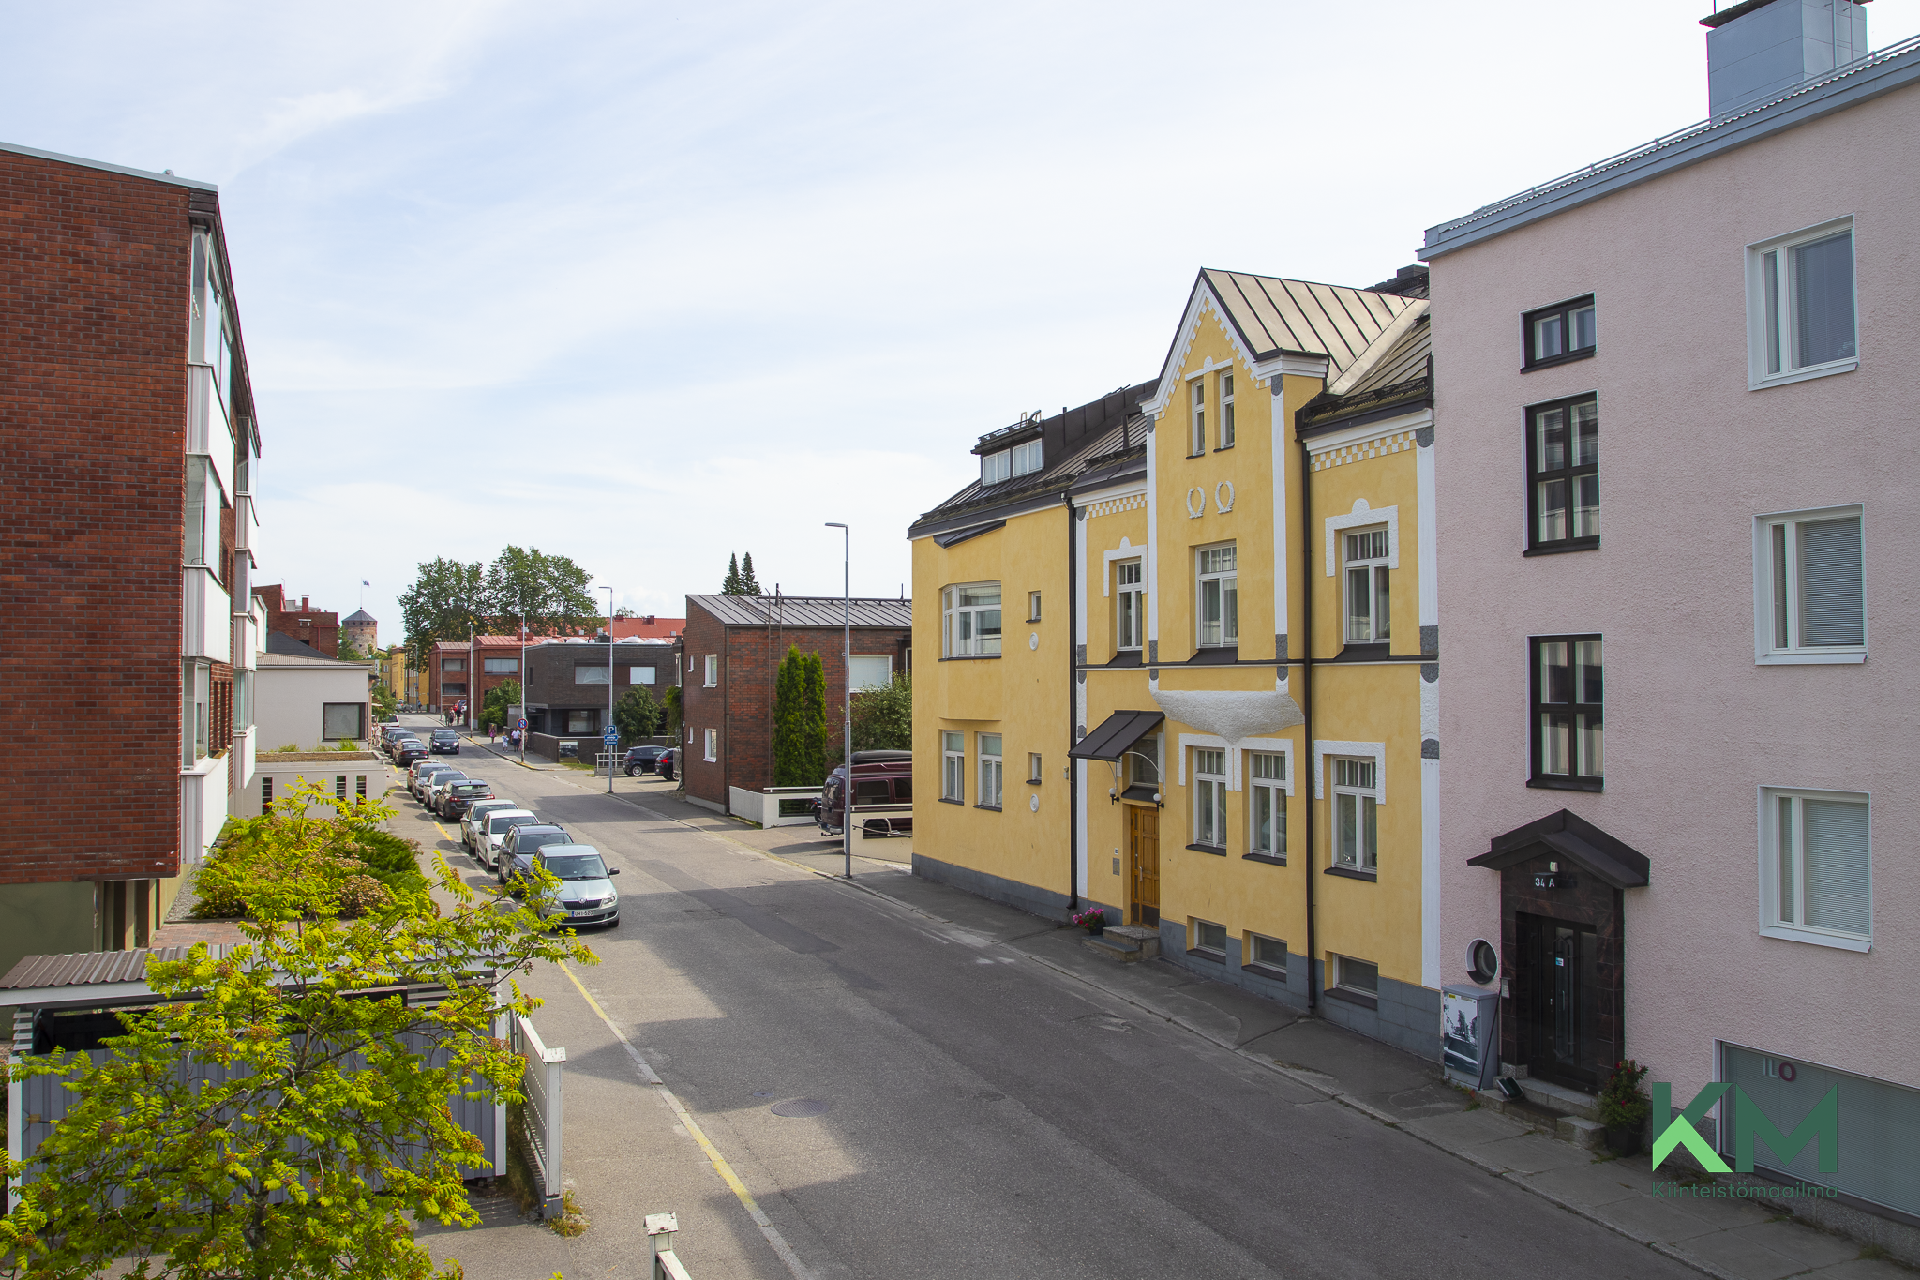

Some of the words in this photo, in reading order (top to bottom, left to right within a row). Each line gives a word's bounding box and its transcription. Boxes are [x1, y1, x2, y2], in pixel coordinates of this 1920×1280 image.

[1535, 877, 1545, 887] 34
[1549, 878, 1555, 888] A
[1762, 1057, 1796, 1082] ILO
